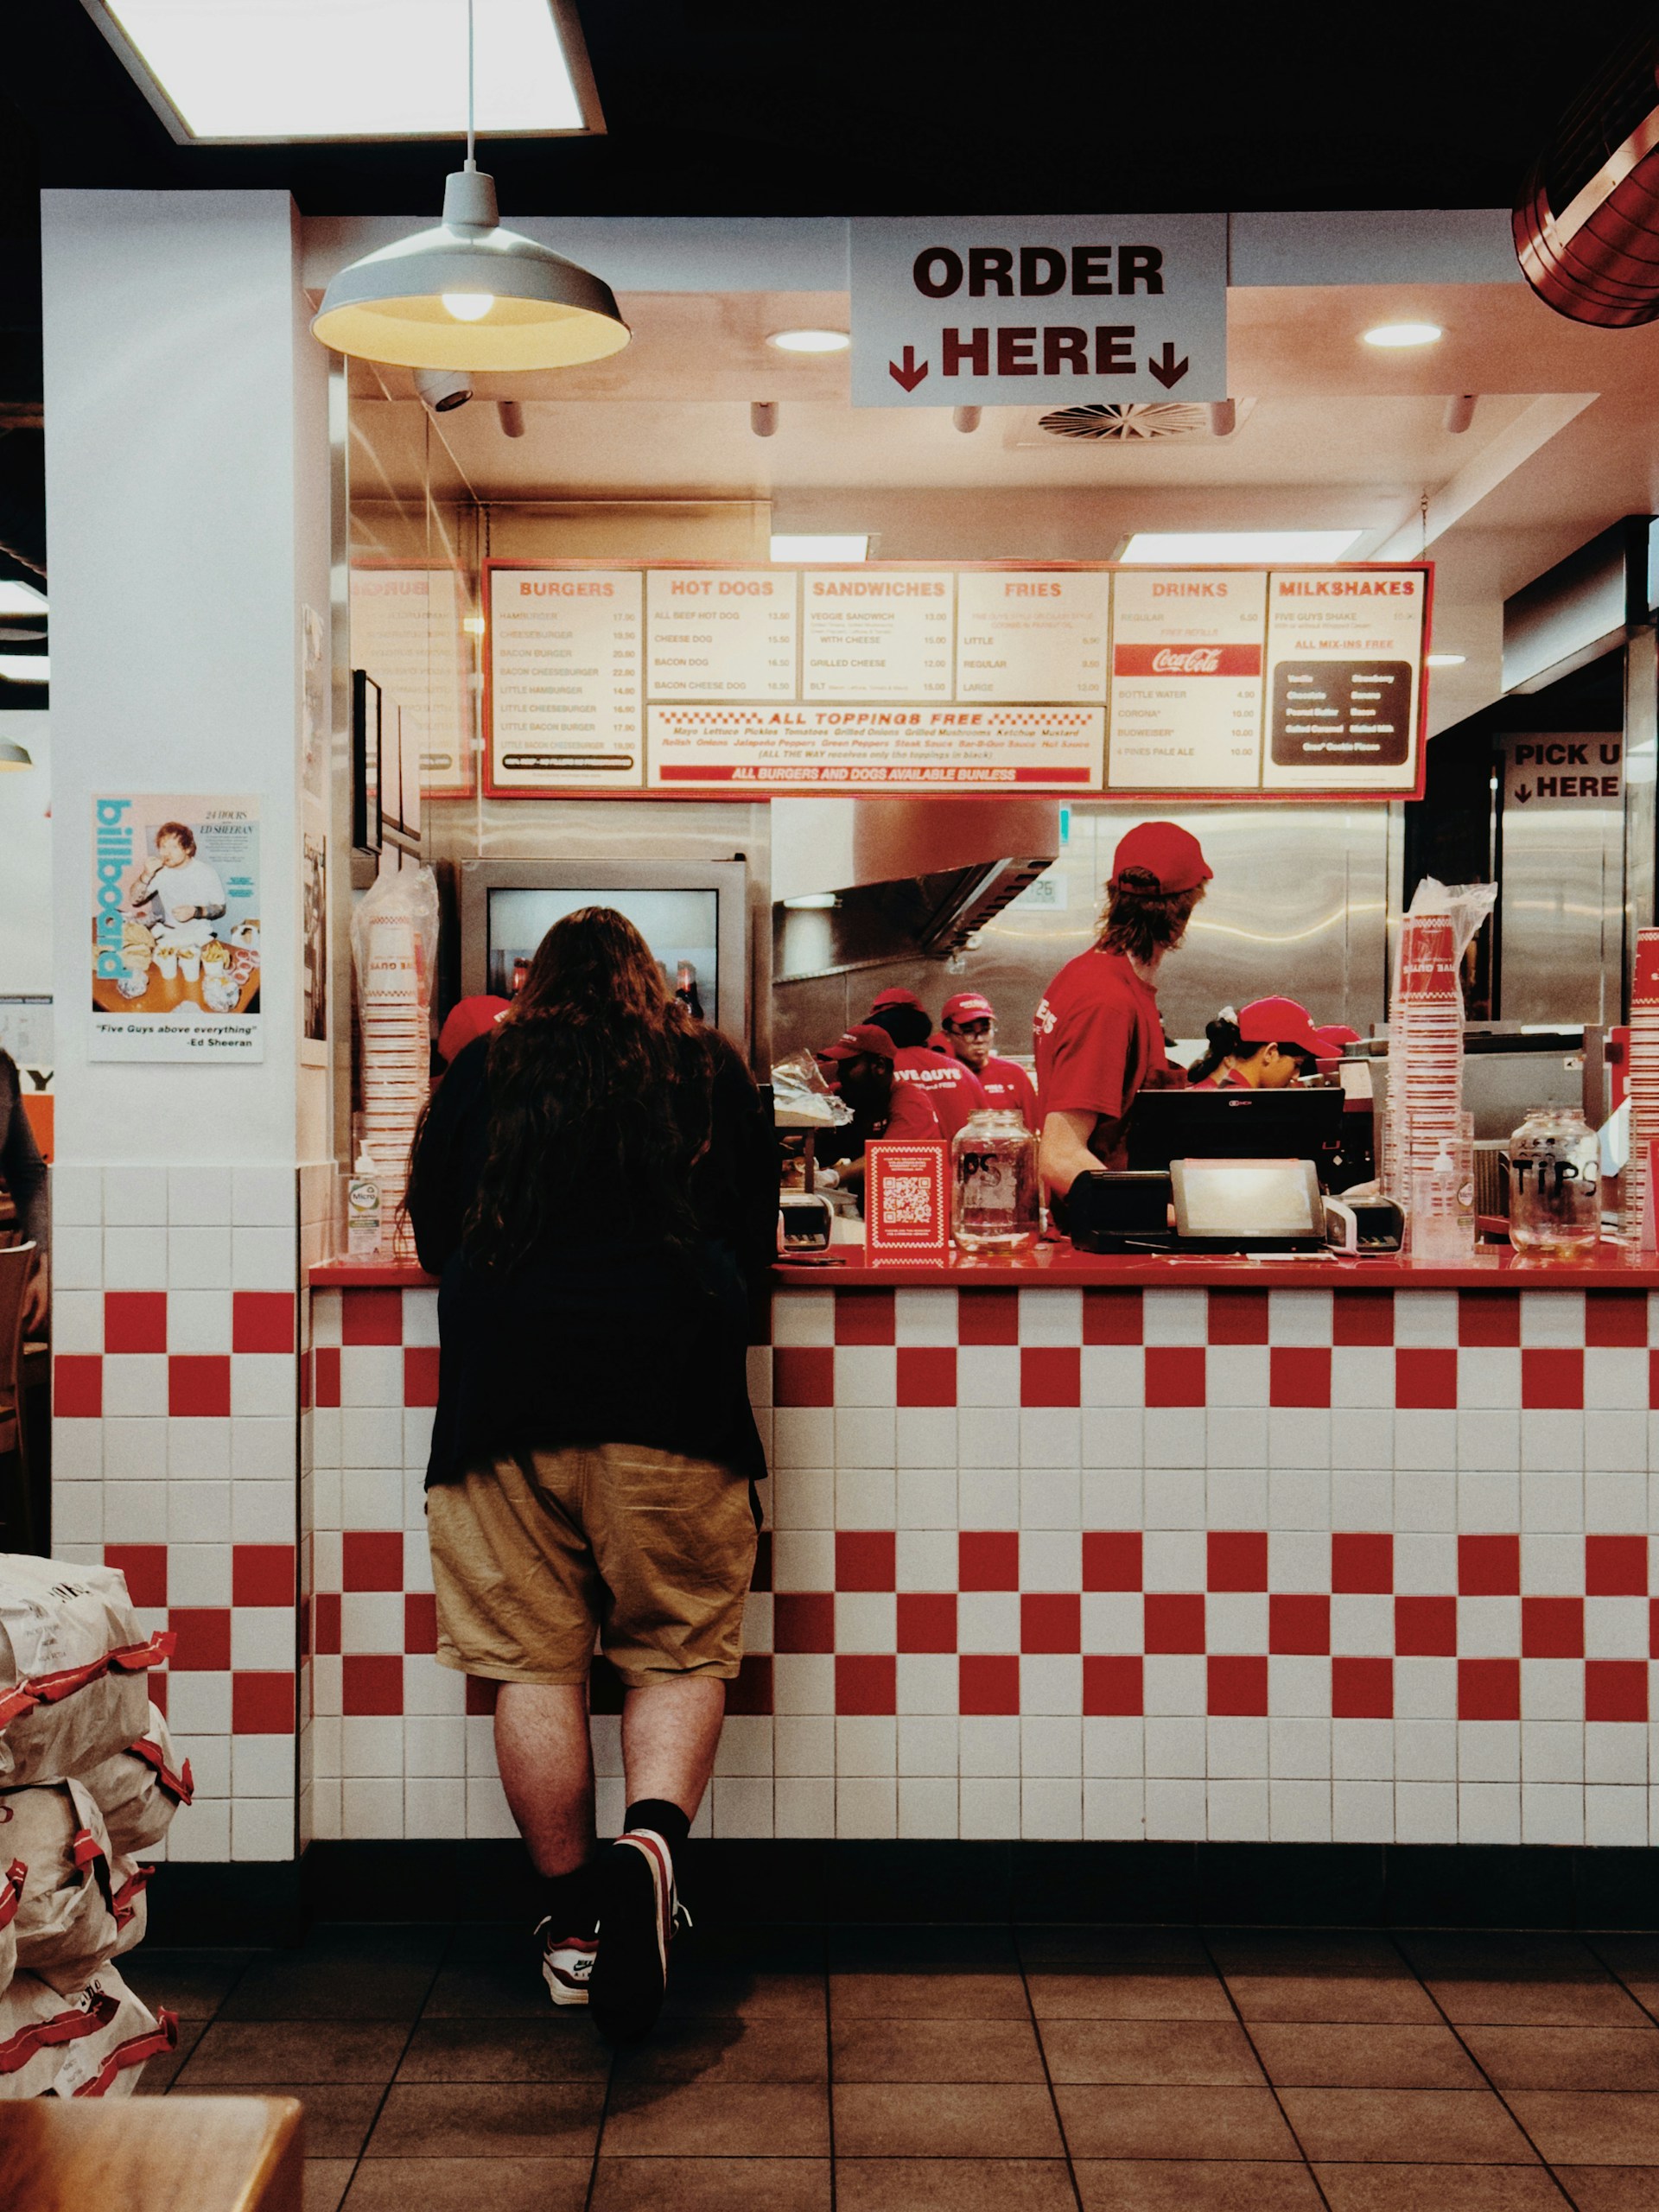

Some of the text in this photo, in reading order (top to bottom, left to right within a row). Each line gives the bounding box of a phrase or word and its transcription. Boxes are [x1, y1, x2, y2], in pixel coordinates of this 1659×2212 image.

[913, 246, 1165, 299] ORDER
[943, 326, 1137, 377] HERE
[519, 582, 615, 597] BURGERS
[671, 581, 774, 596] HOT DOGS
[812, 582, 945, 596] SANDWICHES
[1004, 582, 1063, 597] FRIES
[1152, 582, 1229, 598] DRINKS
[1279, 581, 1415, 596] MILKSHAKES
[654, 612, 671, 620] ALL
[673, 612, 696, 620] BEEF
[698, 612, 717, 620] HOT
[719, 612, 740, 620] DOG
[1121, 613, 1165, 622] REGULAR
[1274, 613, 1357, 621] FIVE GUYS SHAKE
[499, 631, 574, 639] CHEESEBURGER
[820, 636, 843, 645] WITH
[845, 636, 881, 645] CHEESE
[1295, 640, 1395, 650] ALL MIX-INS FREE
[499, 650, 532, 658] BACON
[533, 650, 573, 658] BURGER
[654, 658, 687, 667] BACON
[689, 658, 709, 667] DOG
[924, 660, 946, 669] 12.00
[963, 660, 1007, 669] REGULAR
[500, 668, 531, 677] BACON
[531, 668, 600, 677] CHEESEBURGER
[654, 682, 686, 690] BACON
[688, 682, 724, 690] CHEESE
[726, 682, 747, 690] DOG
[810, 683, 826, 691] BLT
[1118, 690, 1154, 699] BOTTLE
[1155, 690, 1187, 699] WATER
[500, 705, 529, 714] LITTLE
[529, 705, 597, 714] CHEESEBURGER
[1232, 710, 1255, 719] 10.00
[768, 713, 983, 726] ALL TOPPINGS FREE
[501, 723, 529, 732] LITTLE
[530, 723, 560, 732] BACON
[561, 723, 596, 732] BURGER
[673, 728, 1080, 737] Mayo Lettuce Pickles Tomatoes Grilled Onions Grilled Mushrooms Ketchup Mustard
[1231, 729, 1254, 738] 10.00
[662, 739, 692, 748] Relish
[696, 739, 729, 748] Onions
[778, 739, 817, 748] Peppers
[821, 739, 850, 748] Green
[851, 739, 890, 748] Peppers
[894, 739, 923, 748] Steak
[925, 739, 954, 748] Sauce
[1008, 739, 1037, 748] Sauce
[1041, 739, 1059, 748] Hot
[1060, 739, 1090, 748] Sauce
[759, 750, 994, 760] (ALL THE WAY receives only the toppings in black)
[1124, 748, 1152, 757] PINES
[1153, 748, 1176, 757] PALE
[1177, 748, 1195, 757] ALE
[1231, 748, 1253, 757] 10.00
[1515, 744, 1620, 766] PICK U
[732, 767, 1018, 781] ALL BURGERS AND DOGS AVAILABLE BUNLESS
[1537, 777, 1619, 797] HERE
[206, 810, 247, 821] 24 HOURS
[200, 825, 254, 835] ED SHEERAN
[97, 799, 133, 980] billboard
[127, 1025, 154, 1035] Guys
[157, 1025, 190, 1034] above
[187, 1039, 253, 1047] -Ed Sheeran
[893, 1068, 963, 1083] IVE GUYS
